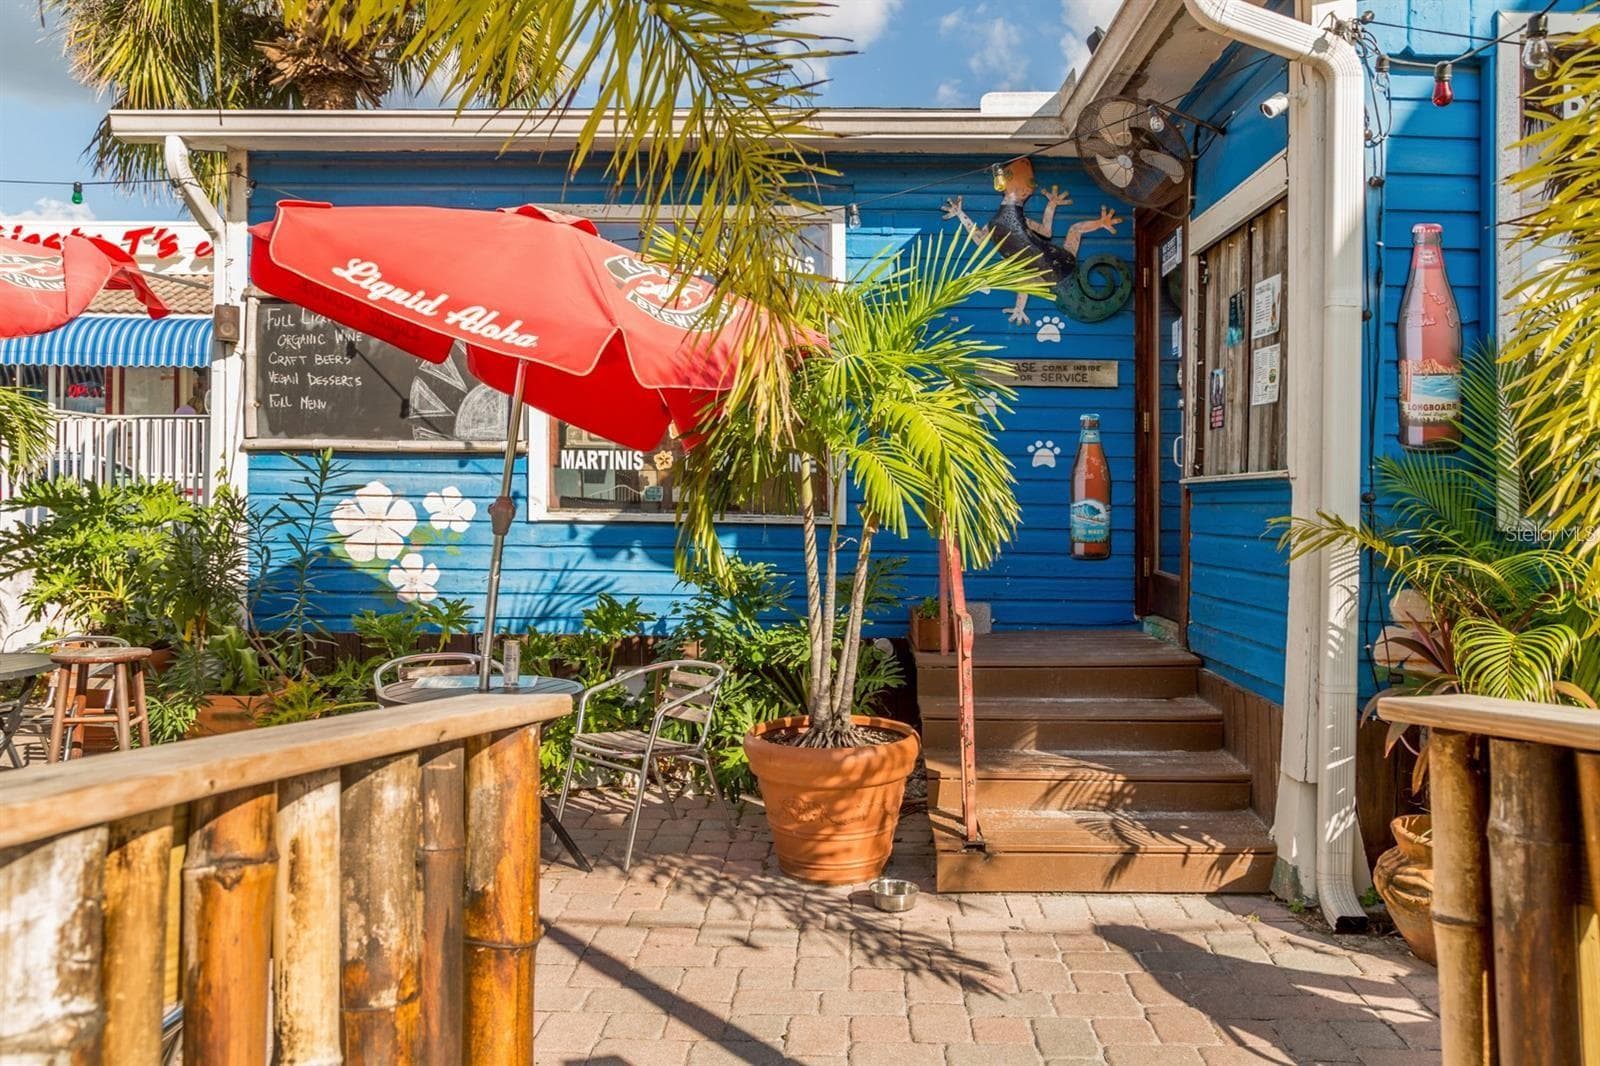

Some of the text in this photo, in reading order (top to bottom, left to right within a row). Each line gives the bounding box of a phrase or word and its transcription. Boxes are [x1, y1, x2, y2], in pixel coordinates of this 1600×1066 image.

[122, 226, 179, 259] T's
[331, 258, 540, 348] Liquid Aloha
[267, 308, 295, 331] FULL
[277, 329, 363, 350] ORGANIC WINE
[268, 351, 352, 366] CRAFT BEERS
[1041, 364, 1068, 372] COME
[1073, 364, 1102, 372] INSIDE
[268, 370, 362, 387] VEGAN DESSERTS
[1041, 373, 1089, 383] SERVICE
[269, 393, 327, 410] FULL MENU
[560, 449, 644, 471] MARTINIS
